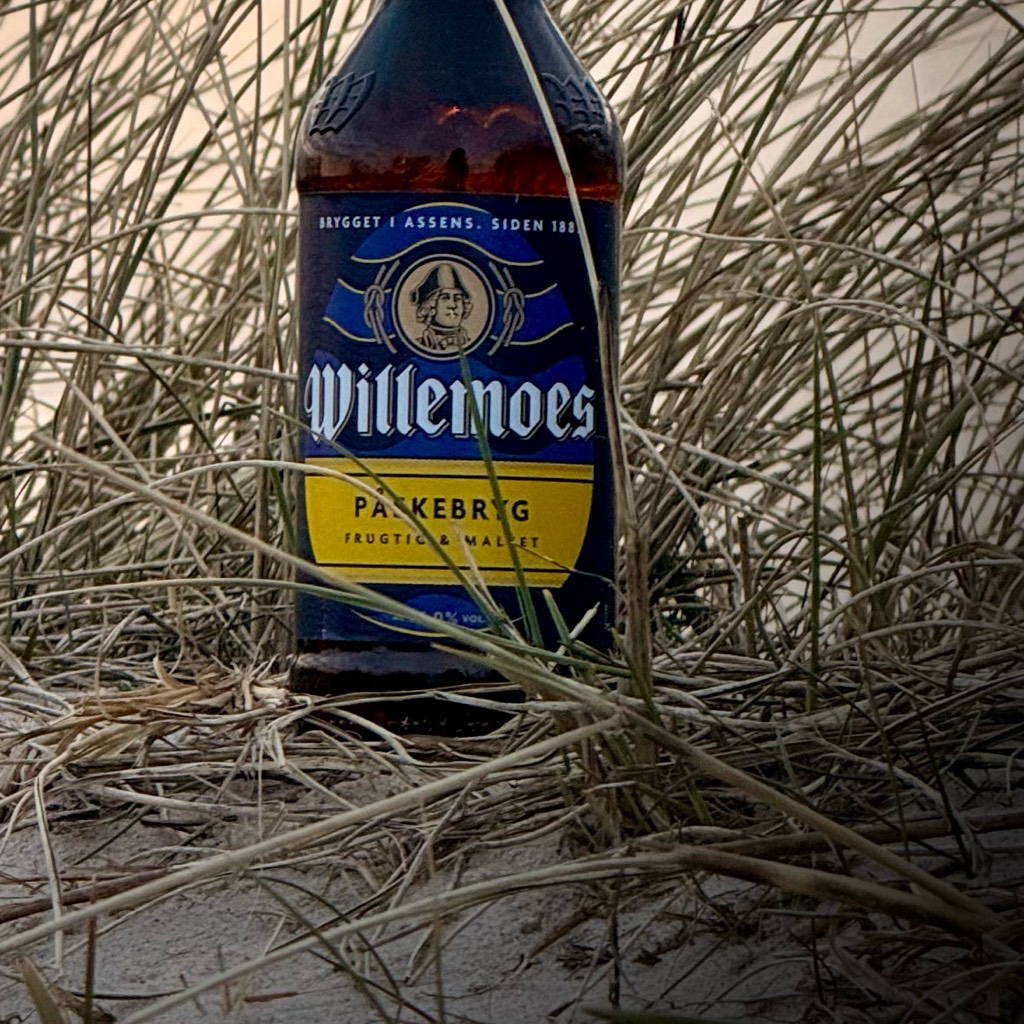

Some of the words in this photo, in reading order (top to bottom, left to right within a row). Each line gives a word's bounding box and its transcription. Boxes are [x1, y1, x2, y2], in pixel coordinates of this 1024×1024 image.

[319, 216, 381, 229] BRYGGET
[390, 216, 395, 228] I
[404, 216, 482, 229] ASSENS.
[491, 217, 544, 231] SIDEN
[551, 220, 582, 234] 188
[304, 362, 596, 443] Willemoes
[439, 534, 450, 545] &
[465, 534, 540, 548] MALET
